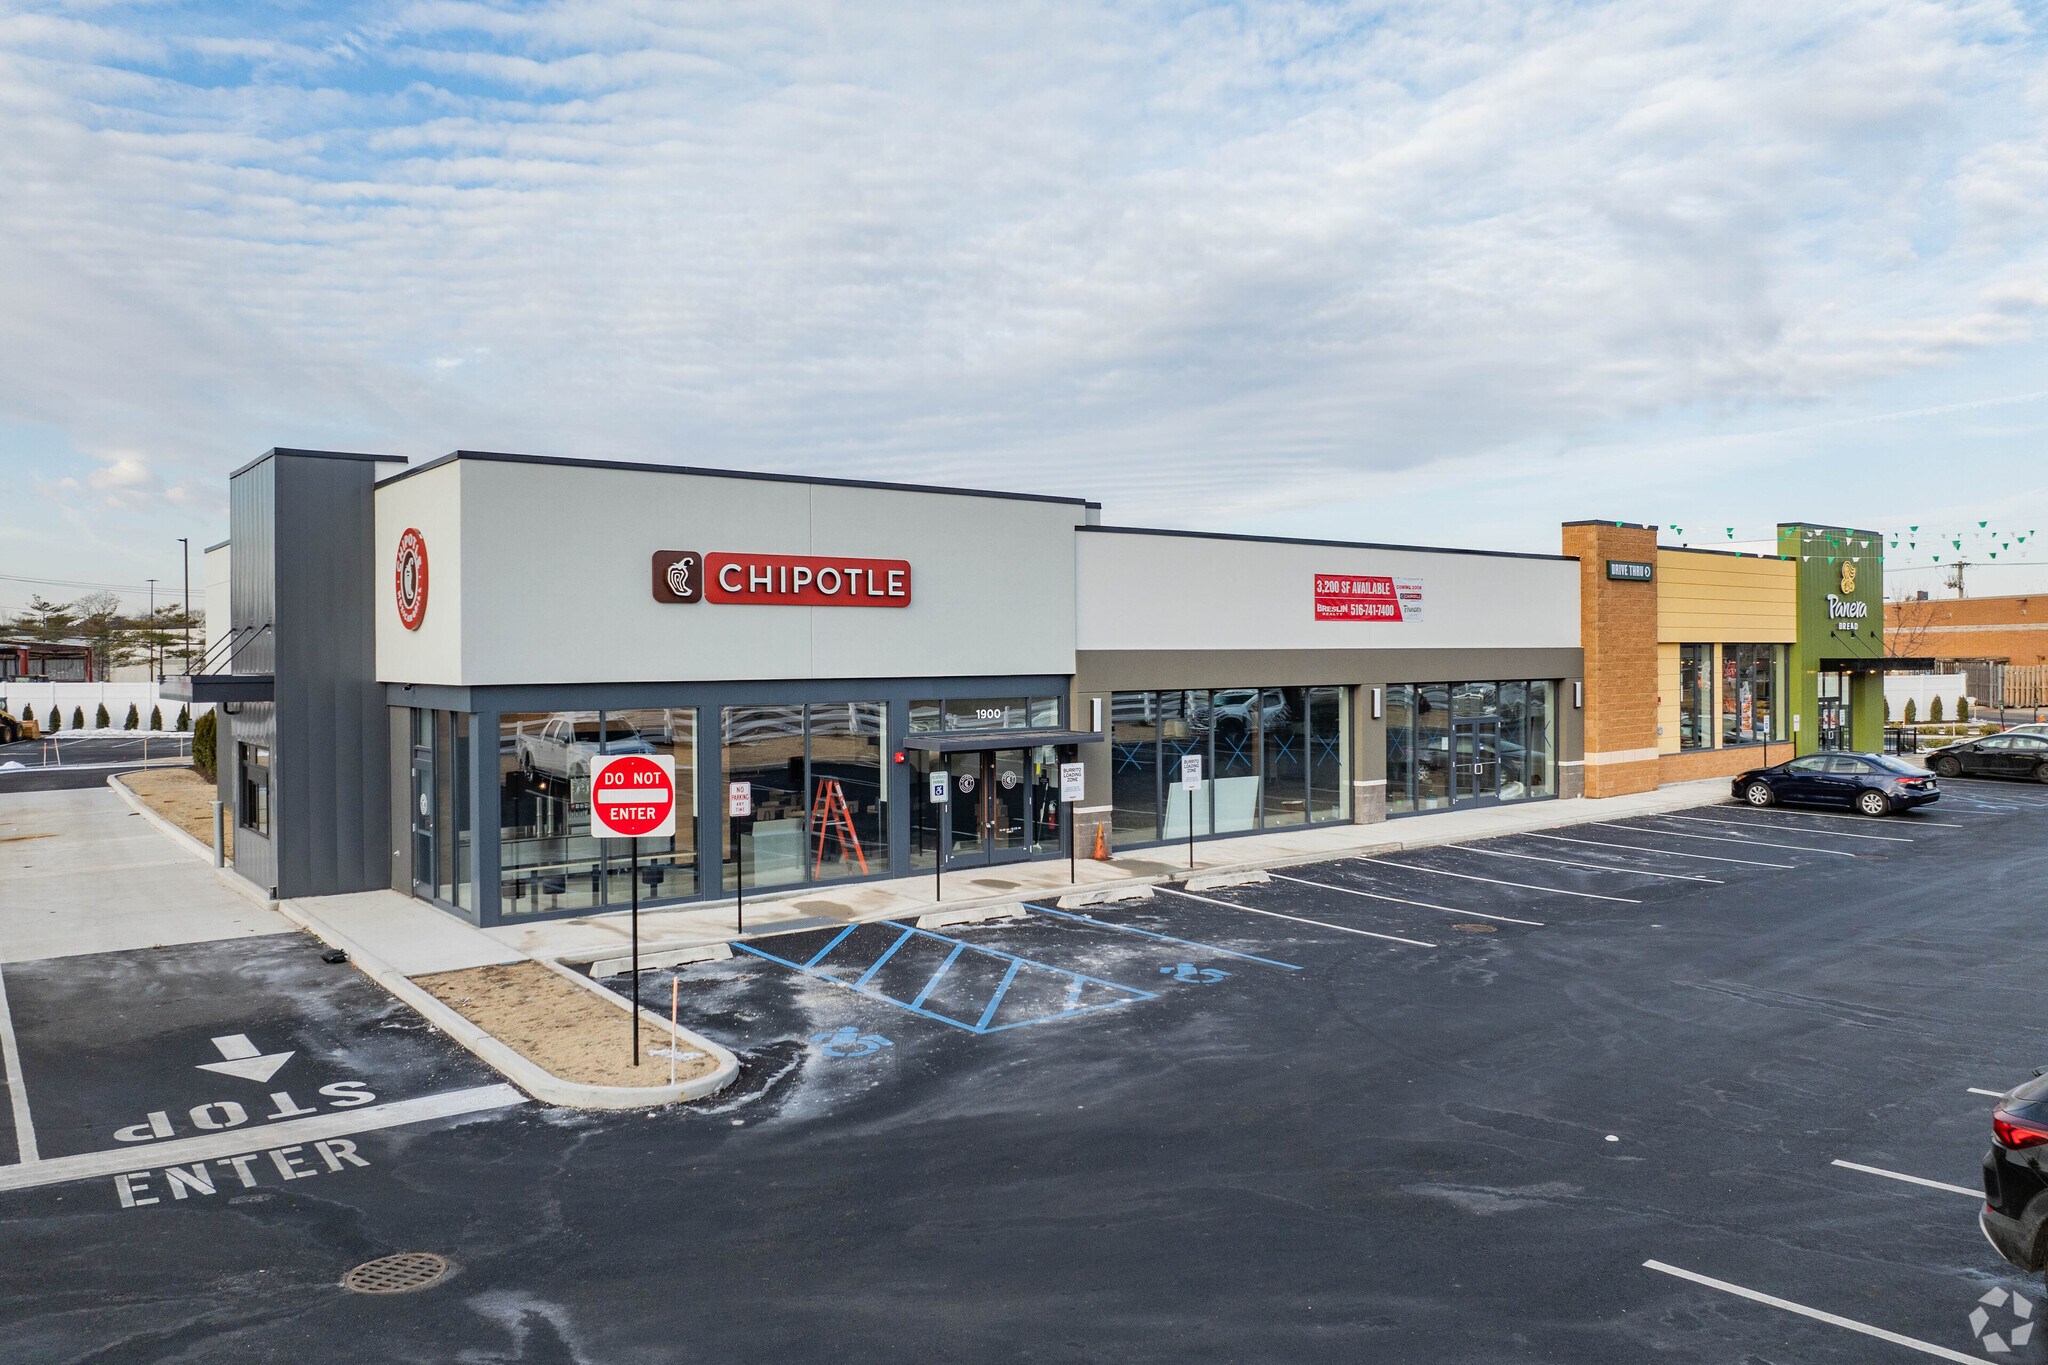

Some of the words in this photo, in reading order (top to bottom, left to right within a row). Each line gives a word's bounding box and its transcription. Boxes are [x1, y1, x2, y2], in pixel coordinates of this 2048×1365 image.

[396, 533, 422, 573] CHIPOTLE
[1611, 563, 1628, 576] DRIVE
[1629, 565, 1644, 577] THRU
[718, 563, 905, 596] CHIPOTLE
[1317, 580, 1339, 593] 3,200
[1341, 581, 1351, 594] SF
[1352, 582, 1390, 595] AVAILABLE
[1317, 603, 1349, 613] BRESLIN
[1350, 603, 1394, 616] 516-741-7400
[1827, 594, 1868, 619] Panera
[1838, 622, 1859, 630] BREAD
[975, 708, 1001, 720] 1900
[605, 772, 624, 785] DO
[633, 772, 661, 784] NOT
[610, 807, 656, 820] ENTER
[113, 1081, 376, 1142] STOP
[114, 1139, 371, 1208] ENTER
